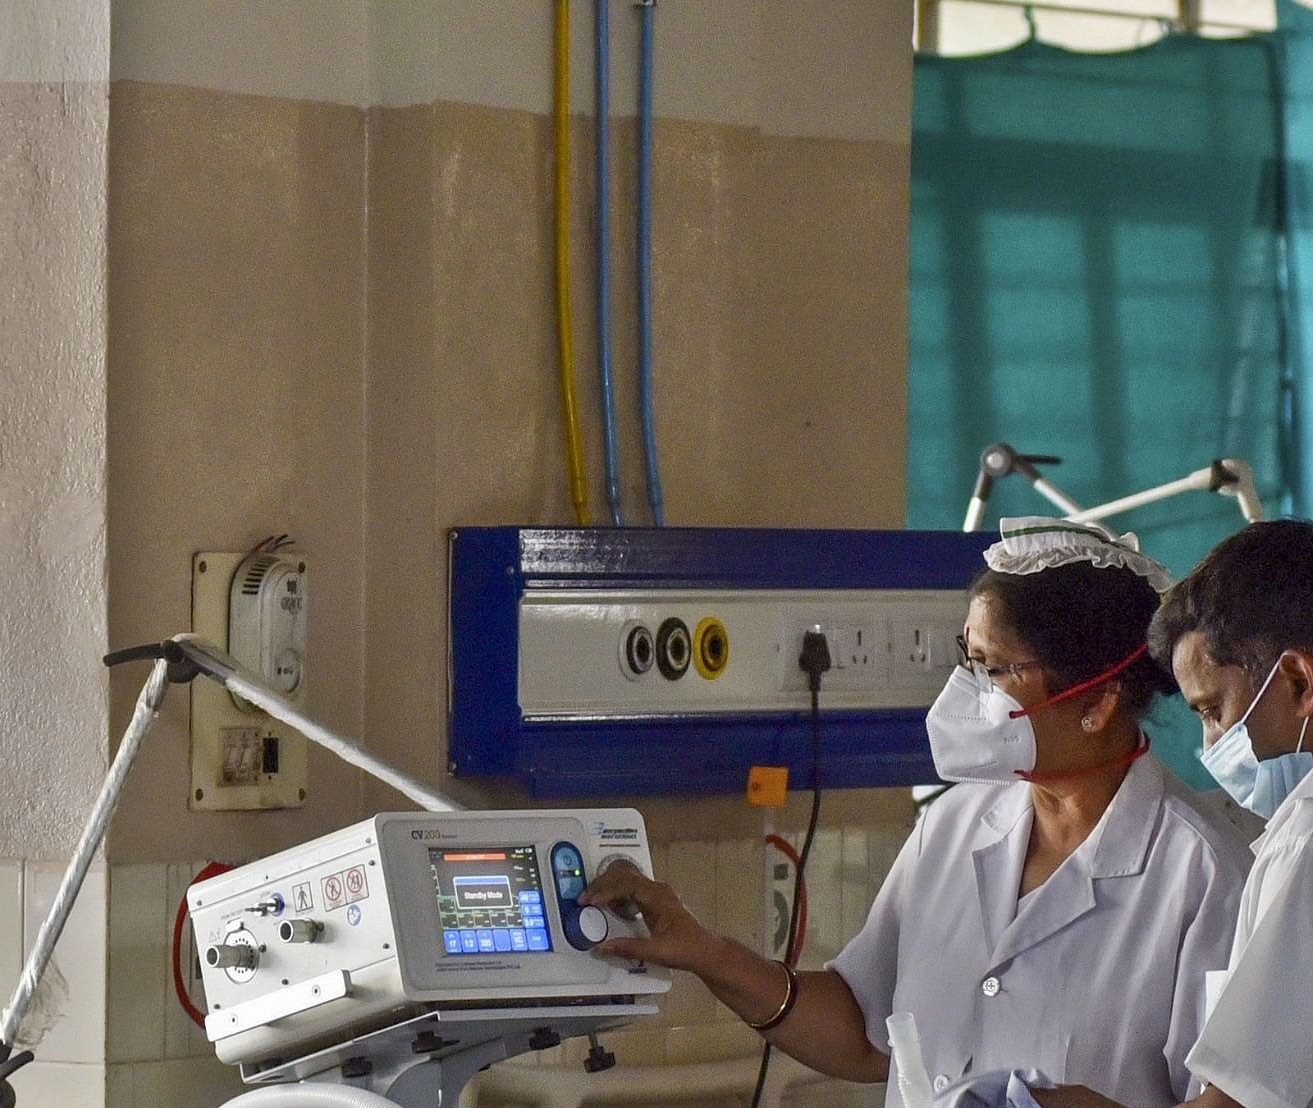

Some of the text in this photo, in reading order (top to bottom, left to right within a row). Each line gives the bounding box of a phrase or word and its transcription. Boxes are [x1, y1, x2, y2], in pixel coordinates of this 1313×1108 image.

[411, 830, 423, 840] CV
[424, 829, 441, 840] 200
[464, 891, 503, 901] Standby Mode
